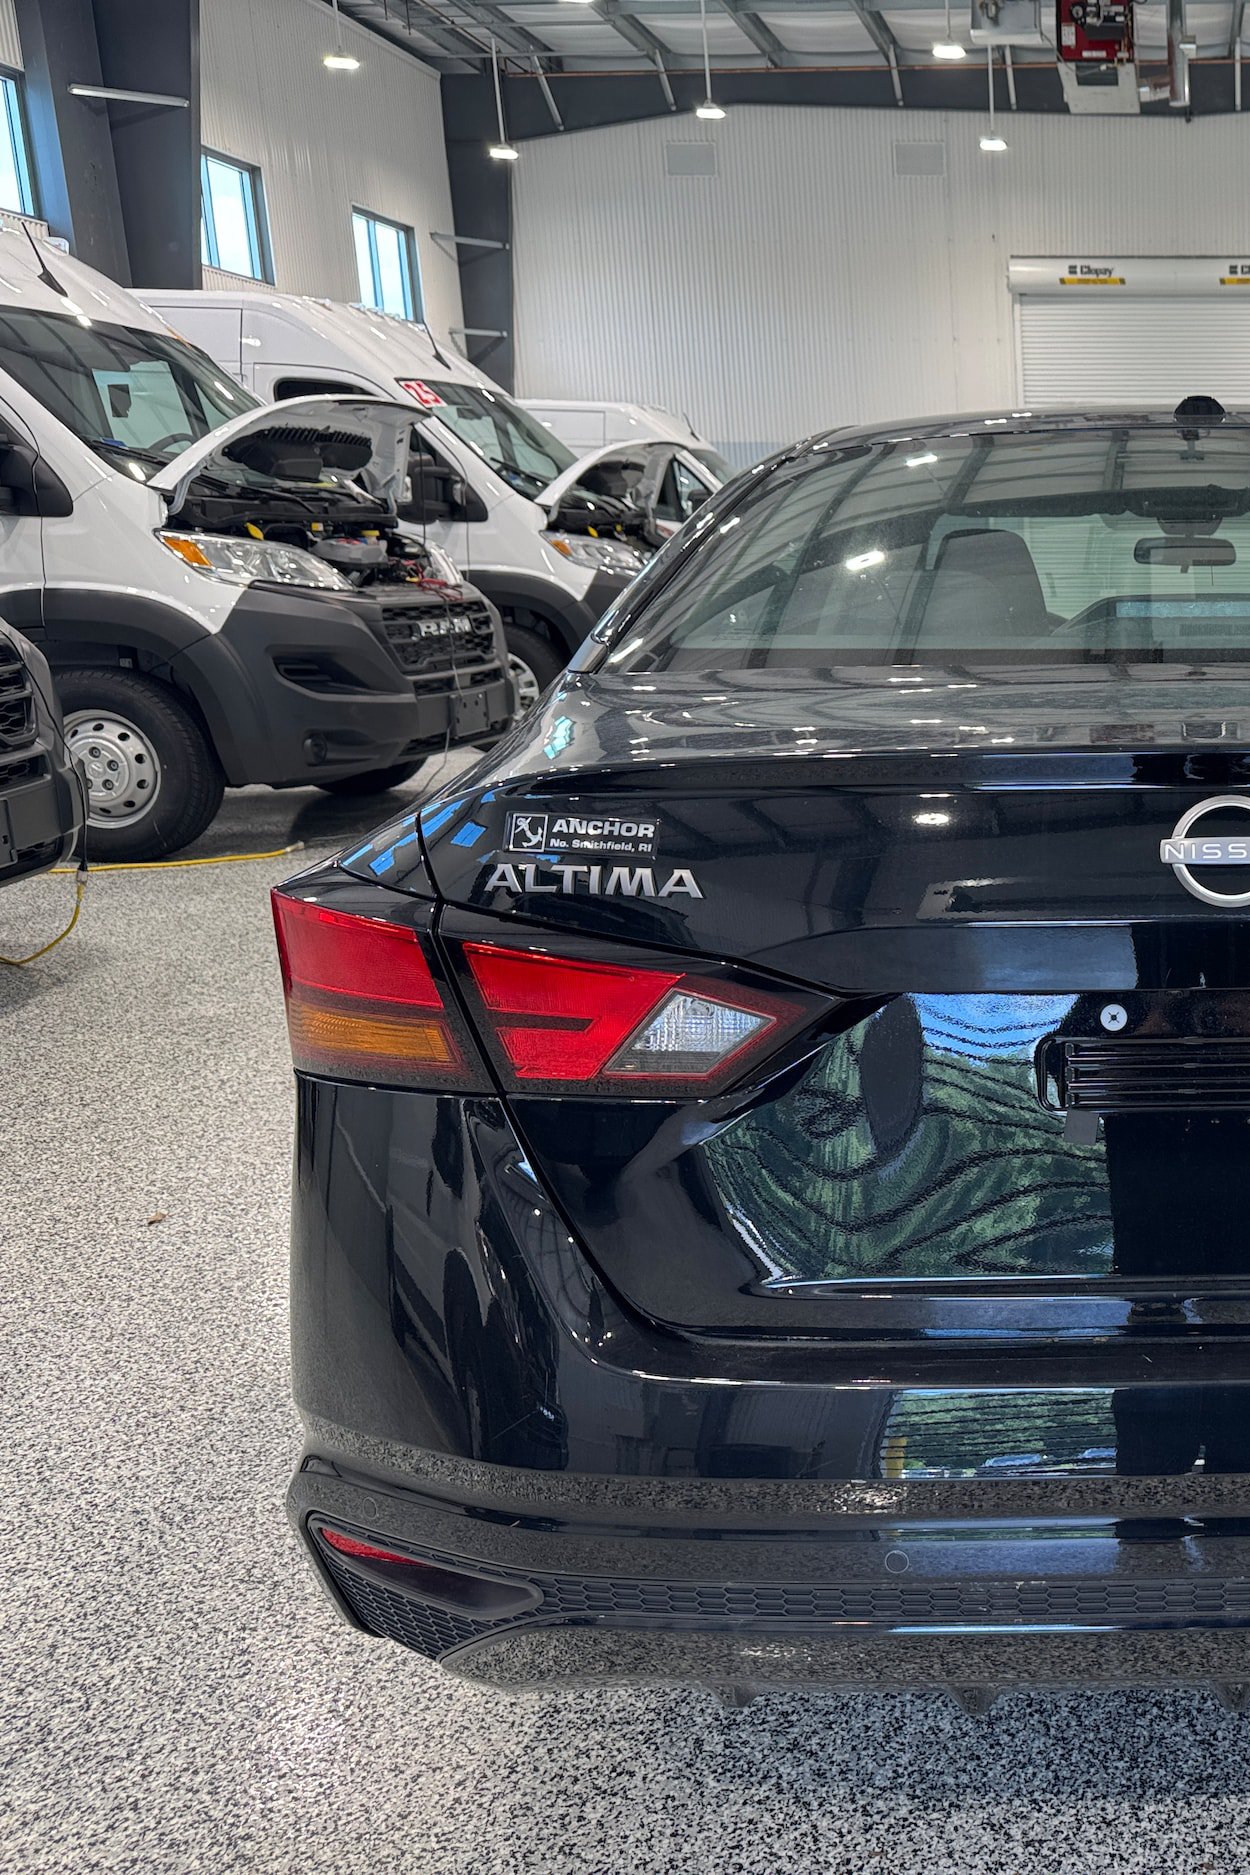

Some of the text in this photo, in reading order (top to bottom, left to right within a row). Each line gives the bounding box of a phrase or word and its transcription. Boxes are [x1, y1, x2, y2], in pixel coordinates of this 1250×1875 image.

[1080, 264, 1114, 278] Clopay
[404, 383, 441, 404] 25
[417, 617, 473, 637] RAM
[552, 818, 656, 838] ANCHOR
[549, 838, 653, 853] No. Smithfield, RI
[483, 863, 704, 899] ALTIMA
